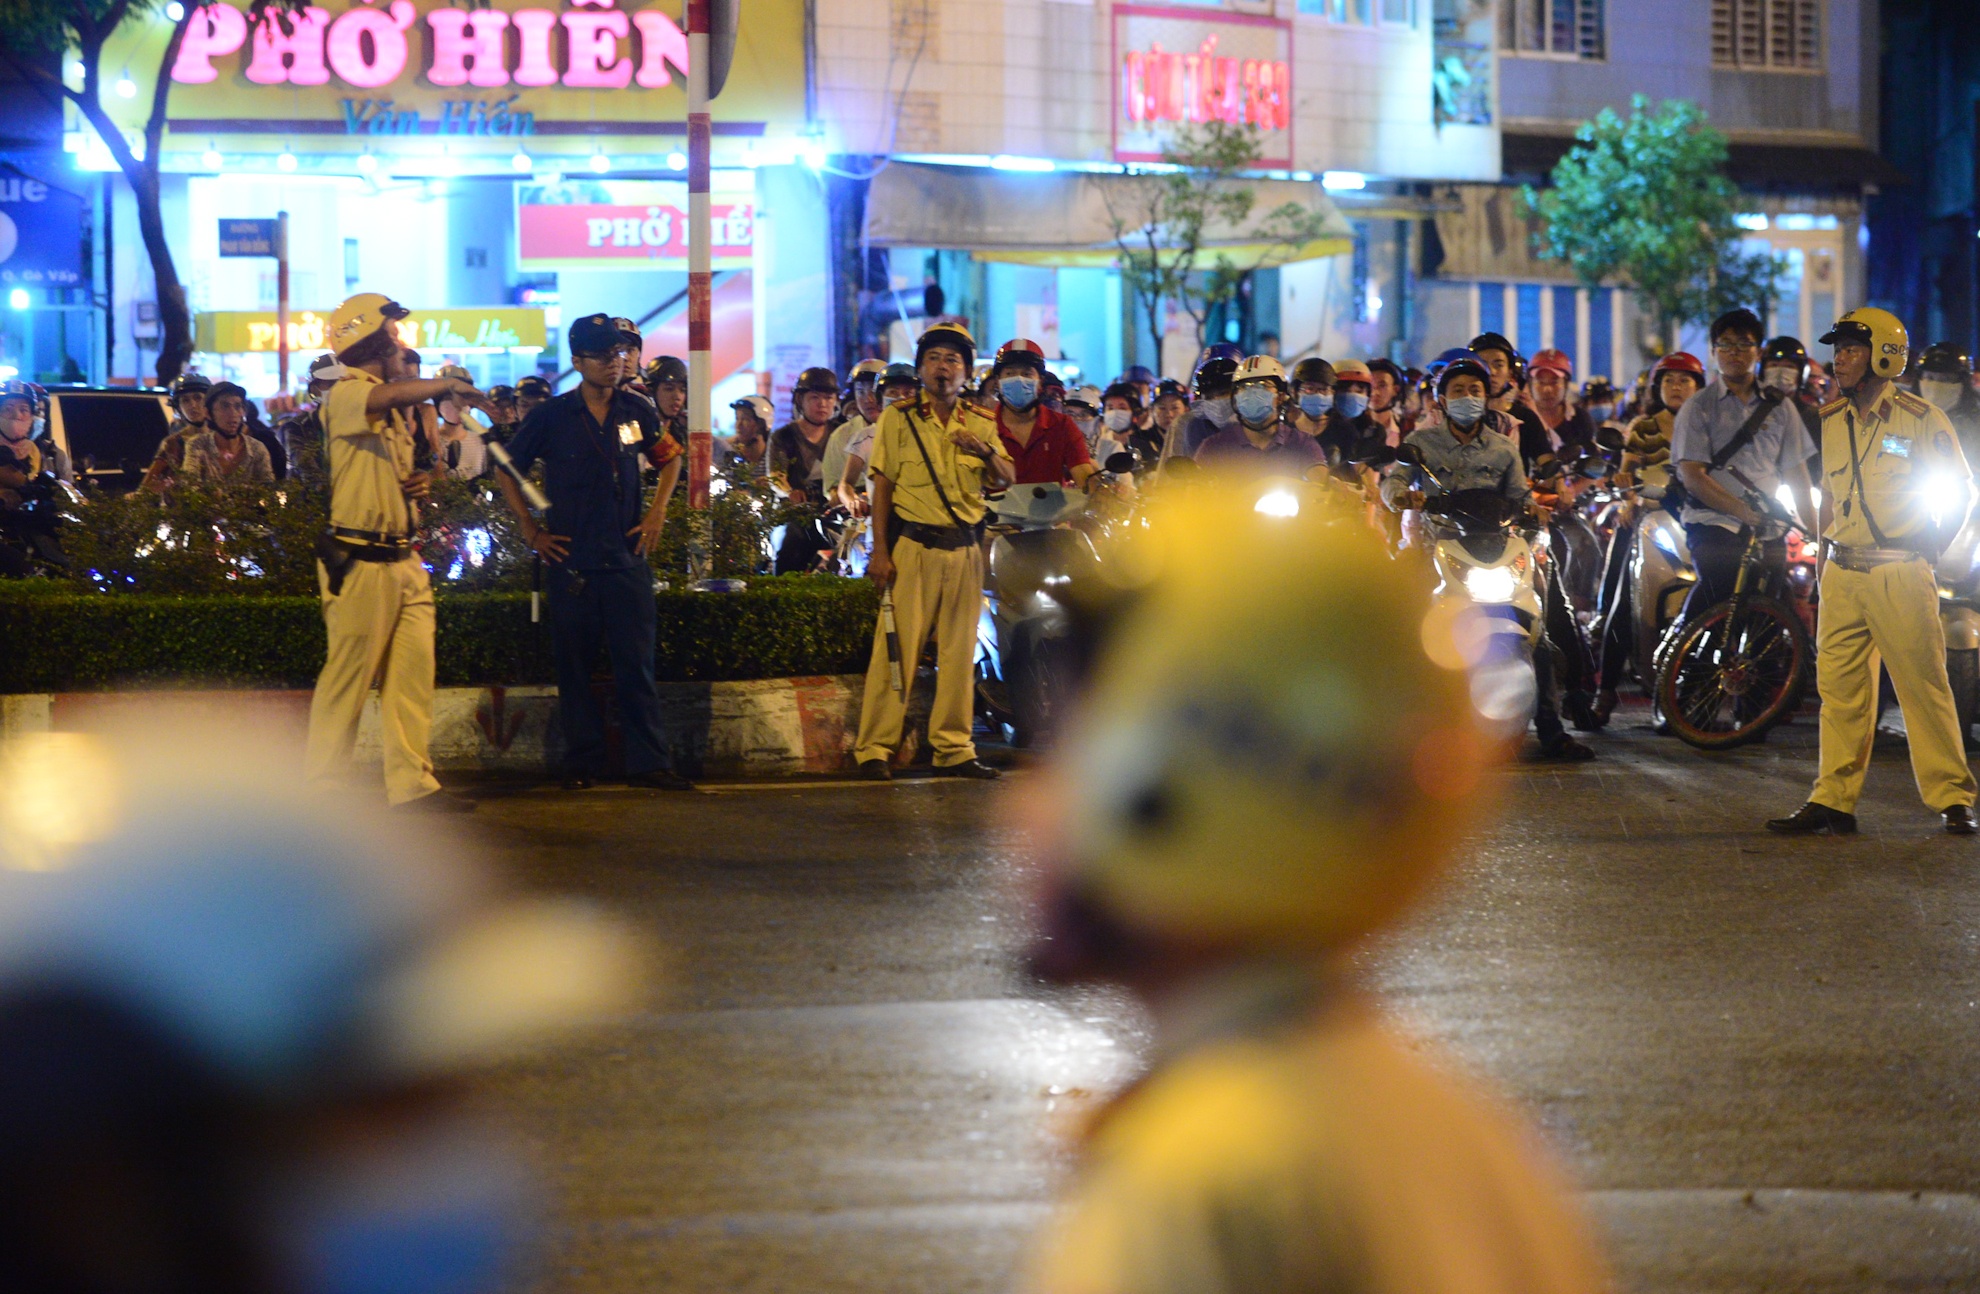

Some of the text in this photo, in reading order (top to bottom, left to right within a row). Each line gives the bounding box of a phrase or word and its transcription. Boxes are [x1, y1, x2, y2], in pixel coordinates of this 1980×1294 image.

[342, 94, 534, 135] Văn Hiến
[586, 206, 672, 247] PHỞ
